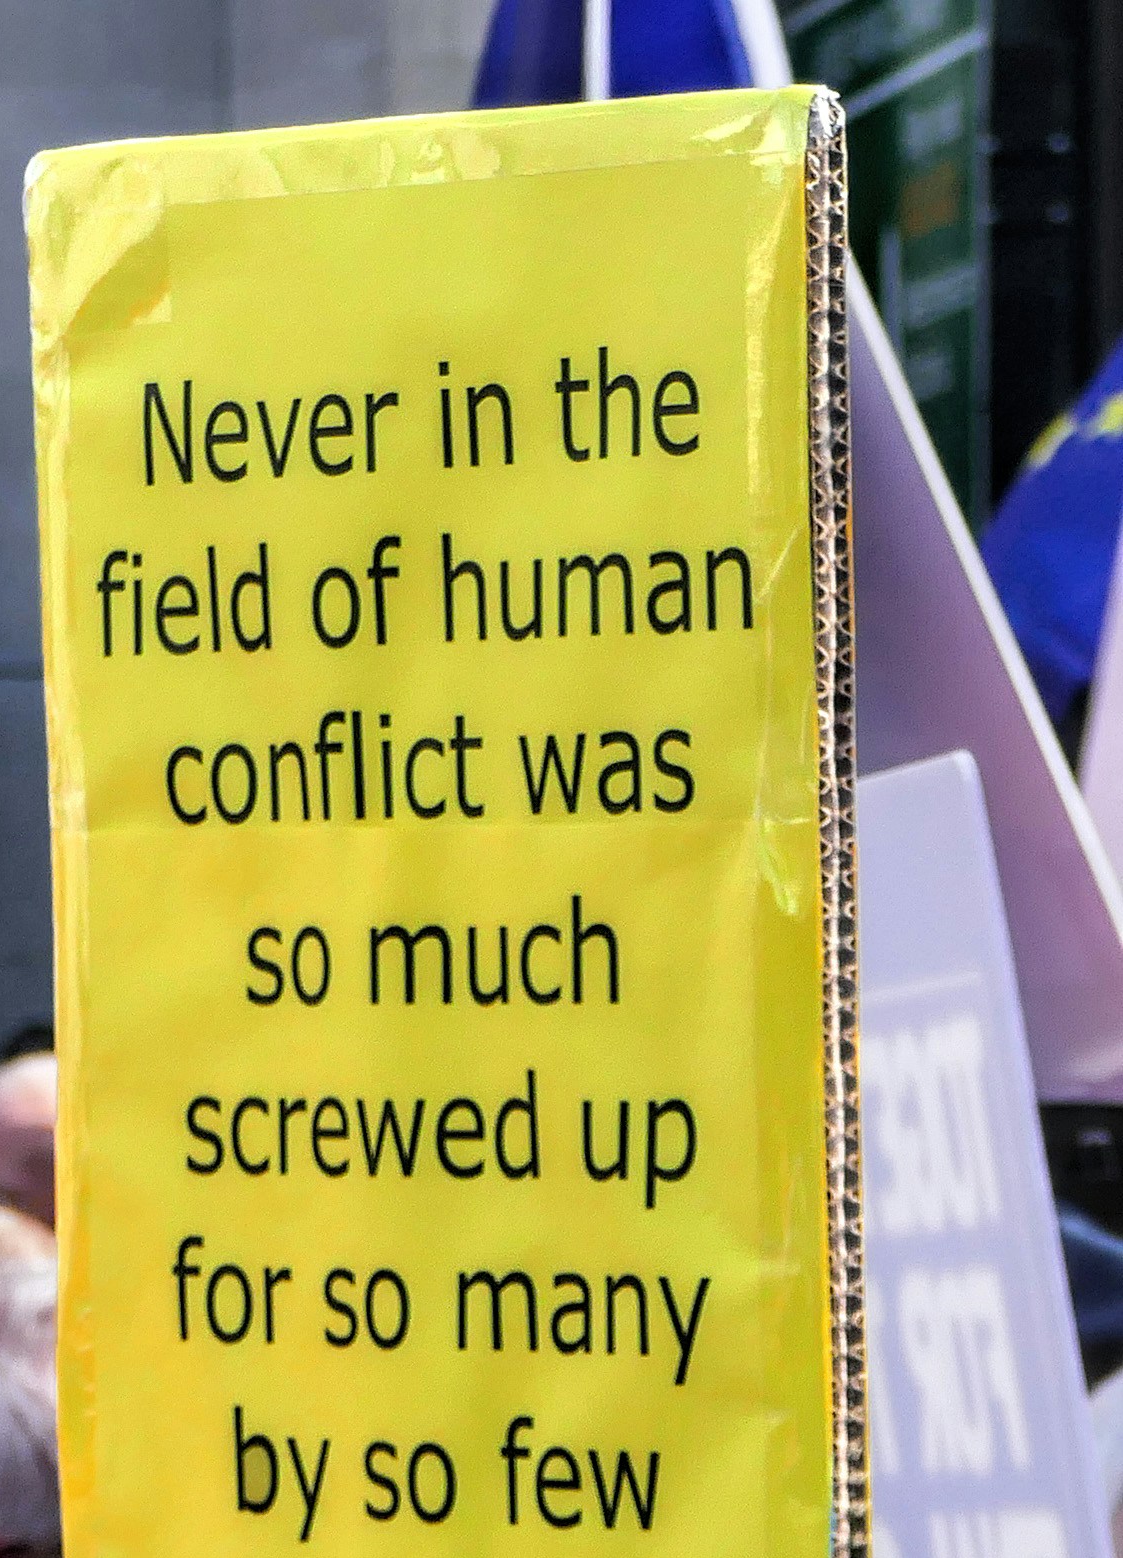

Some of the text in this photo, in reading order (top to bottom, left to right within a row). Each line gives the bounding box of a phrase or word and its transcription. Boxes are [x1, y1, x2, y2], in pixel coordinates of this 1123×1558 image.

[142, 346, 699, 486] Never in the
[96, 532, 755, 657] field of human
[166, 710, 695, 826] conflict was
[246, 894, 620, 1007] so much
[186, 1068, 697, 1210] screwed up
[172, 1235, 711, 1386] for so many
[233, 1405, 661, 1542] by so few
